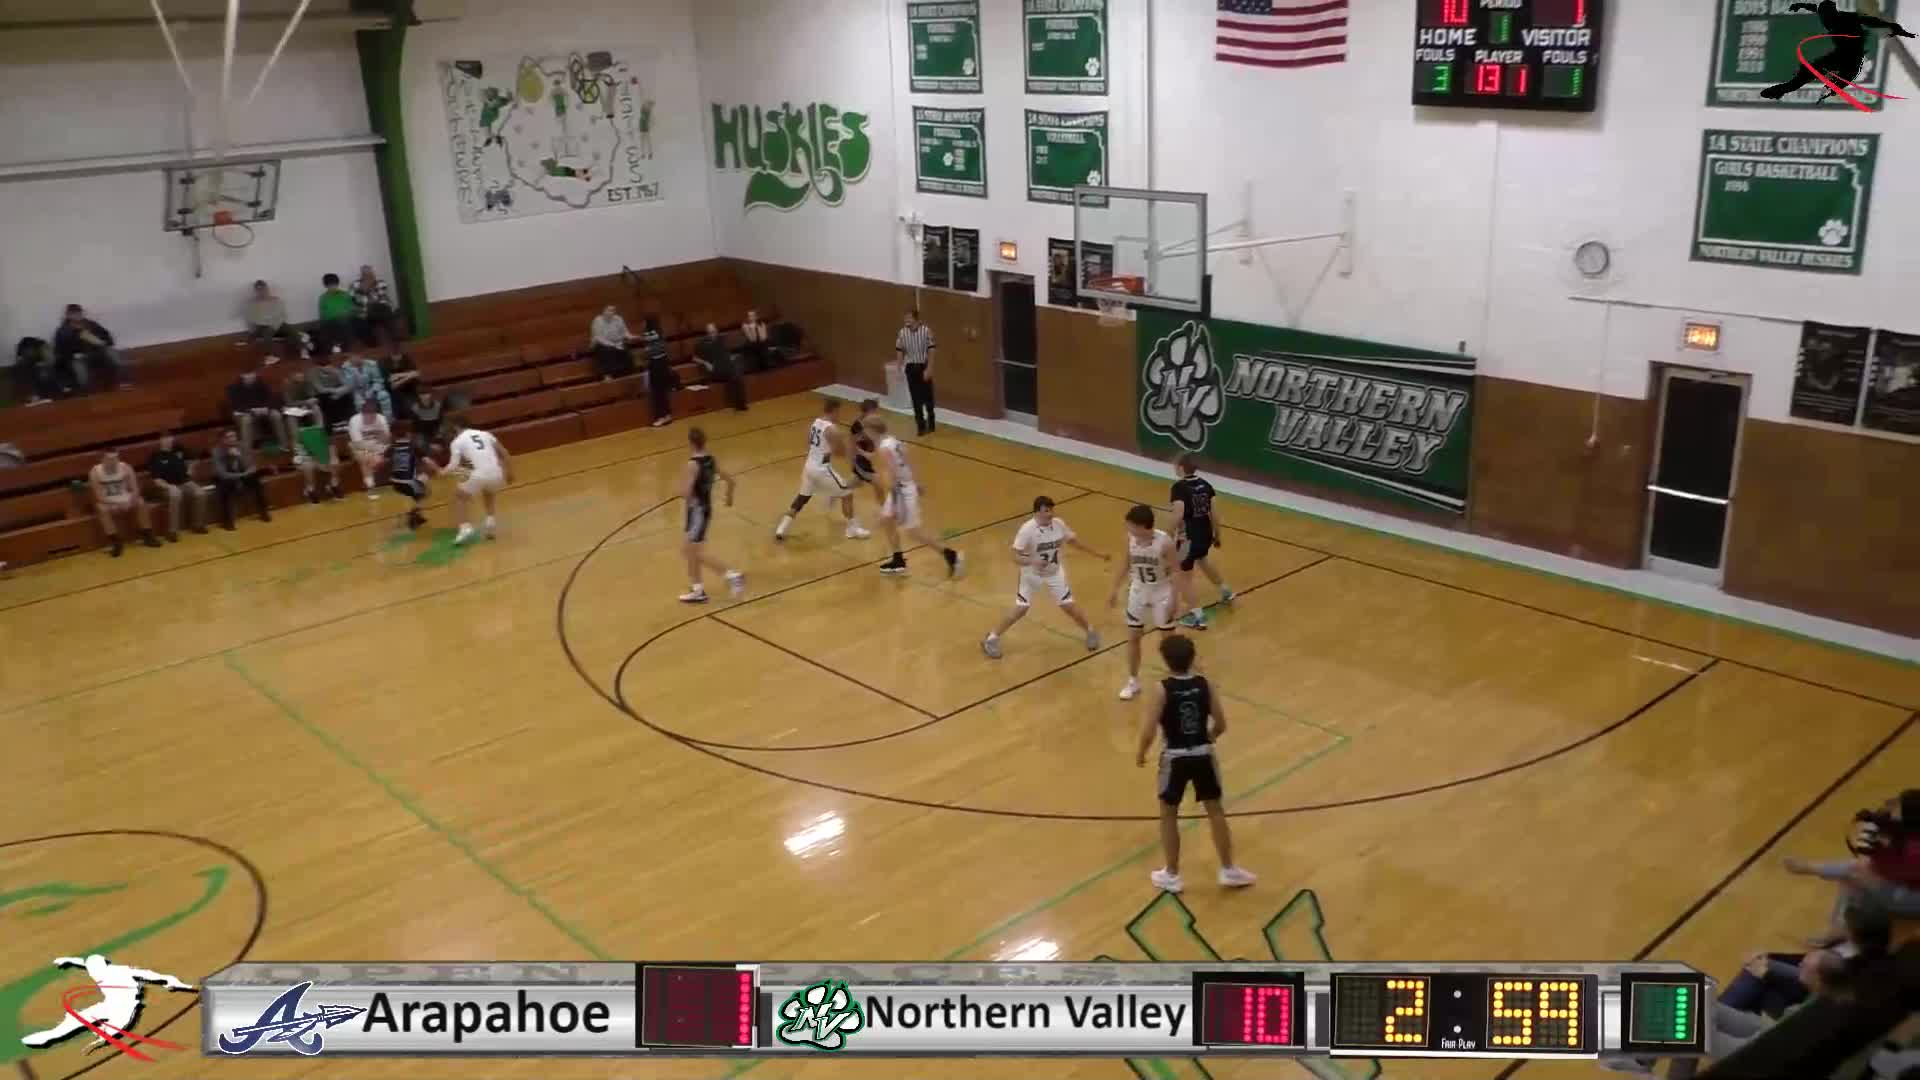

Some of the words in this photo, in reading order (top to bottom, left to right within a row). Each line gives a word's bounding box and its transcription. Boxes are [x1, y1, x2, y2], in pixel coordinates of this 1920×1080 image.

[1420, 29, 1477, 45] HOME
[1522, 29, 1591, 46] VISITOR
[1416, 49, 1455, 61] FOULS
[1475, 50, 1523, 63] PLAYER
[1543, 51, 1587, 64] FOULS
[1433, 65, 1448, 91] 3
[1709, 135, 1726, 150] 1A
[1729, 136, 1773, 153] STATE
[1777, 137, 1869, 156] CHAMPIONS
[712, 103, 871, 216] HUSKIES
[1715, 161, 1753, 176] GIRLS
[1755, 164, 1838, 181] BASKETBALL
[1228, 356, 1467, 432] NORTHERN
[472, 434, 484, 450] 5
[1270, 405, 1444, 473] VALLEY
[1138, 566, 1157, 583] 15
[1179, 701, 1200, 734] 2
